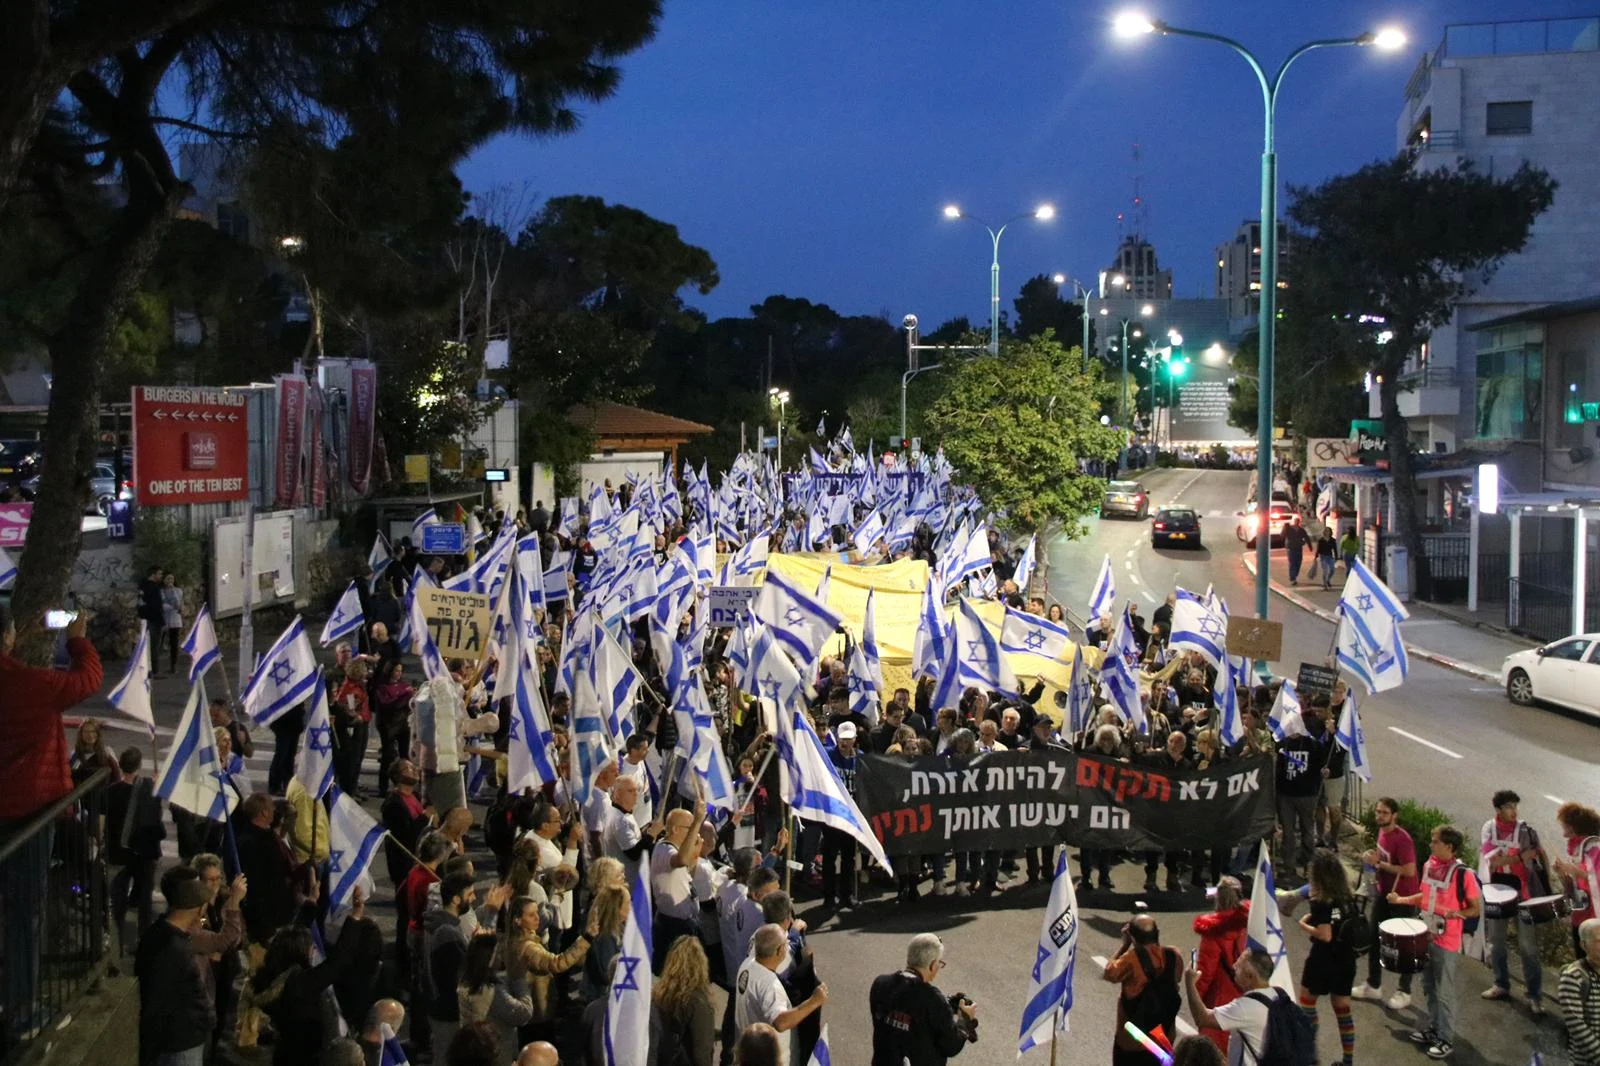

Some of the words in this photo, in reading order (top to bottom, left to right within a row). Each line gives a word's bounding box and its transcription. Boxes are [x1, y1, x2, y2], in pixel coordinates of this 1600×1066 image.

[144, 387, 191, 402] BURGERS
[192, 391, 200, 404] IN
[202, 392, 217, 405] THE
[217, 393, 244, 406] WORLD
[149, 480, 173, 494] ONE
[174, 480, 184, 494] OF
[188, 480, 204, 492] THE
[206, 478, 221, 492] TEN
[223, 477, 242, 490] BEST
[438, 607, 451, 616] פה
[459, 609, 474, 618] עם
[902, 768, 980, 802] אזרח,
[986, 760, 1066, 791] להיות
[1076, 758, 1171, 802] תקום
[1227, 768, 1259, 797] אם
[1179, 778, 1218, 800] לא
[872, 804, 934, 845] נתין
[938, 804, 1000, 840] אותך
[1009, 802, 1078, 828] יעשו
[1090, 805, 1130, 830] הם
